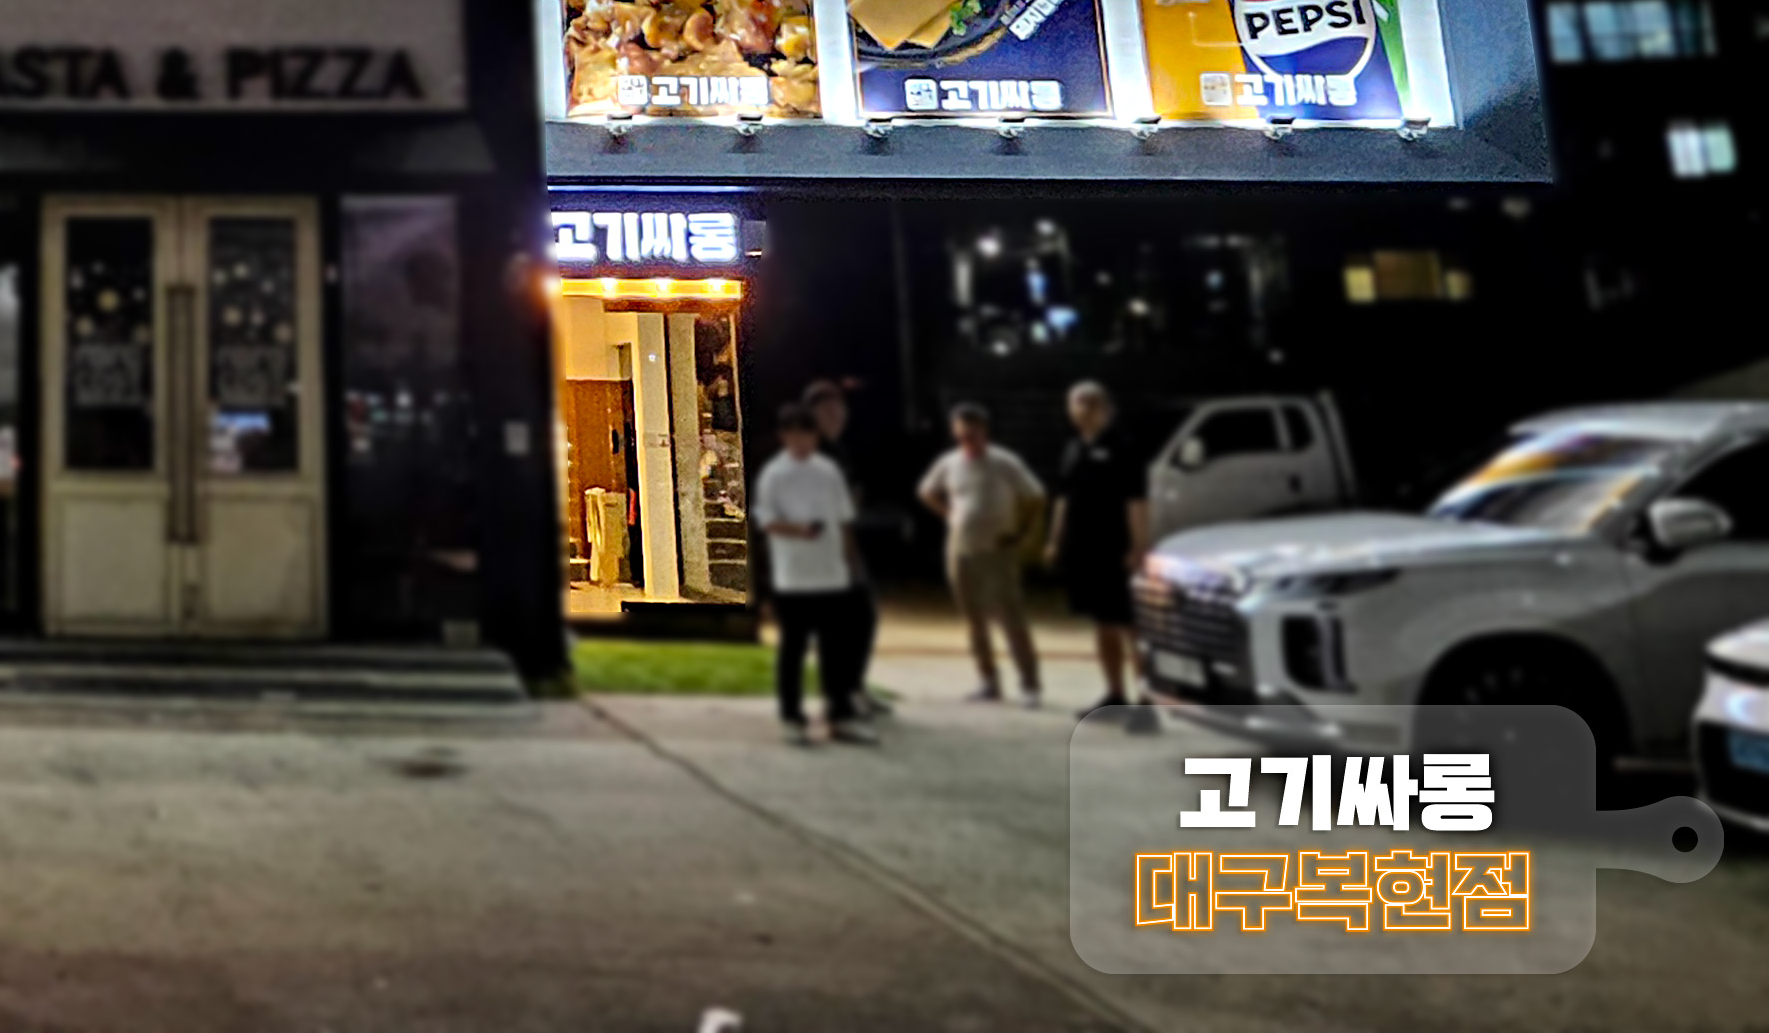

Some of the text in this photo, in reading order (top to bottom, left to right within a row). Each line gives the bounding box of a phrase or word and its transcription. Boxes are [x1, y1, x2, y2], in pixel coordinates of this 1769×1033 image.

[155, 46, 199, 100] &
[224, 46, 425, 100] PIZZA
[551, 211, 738, 263] 고기싸롱
